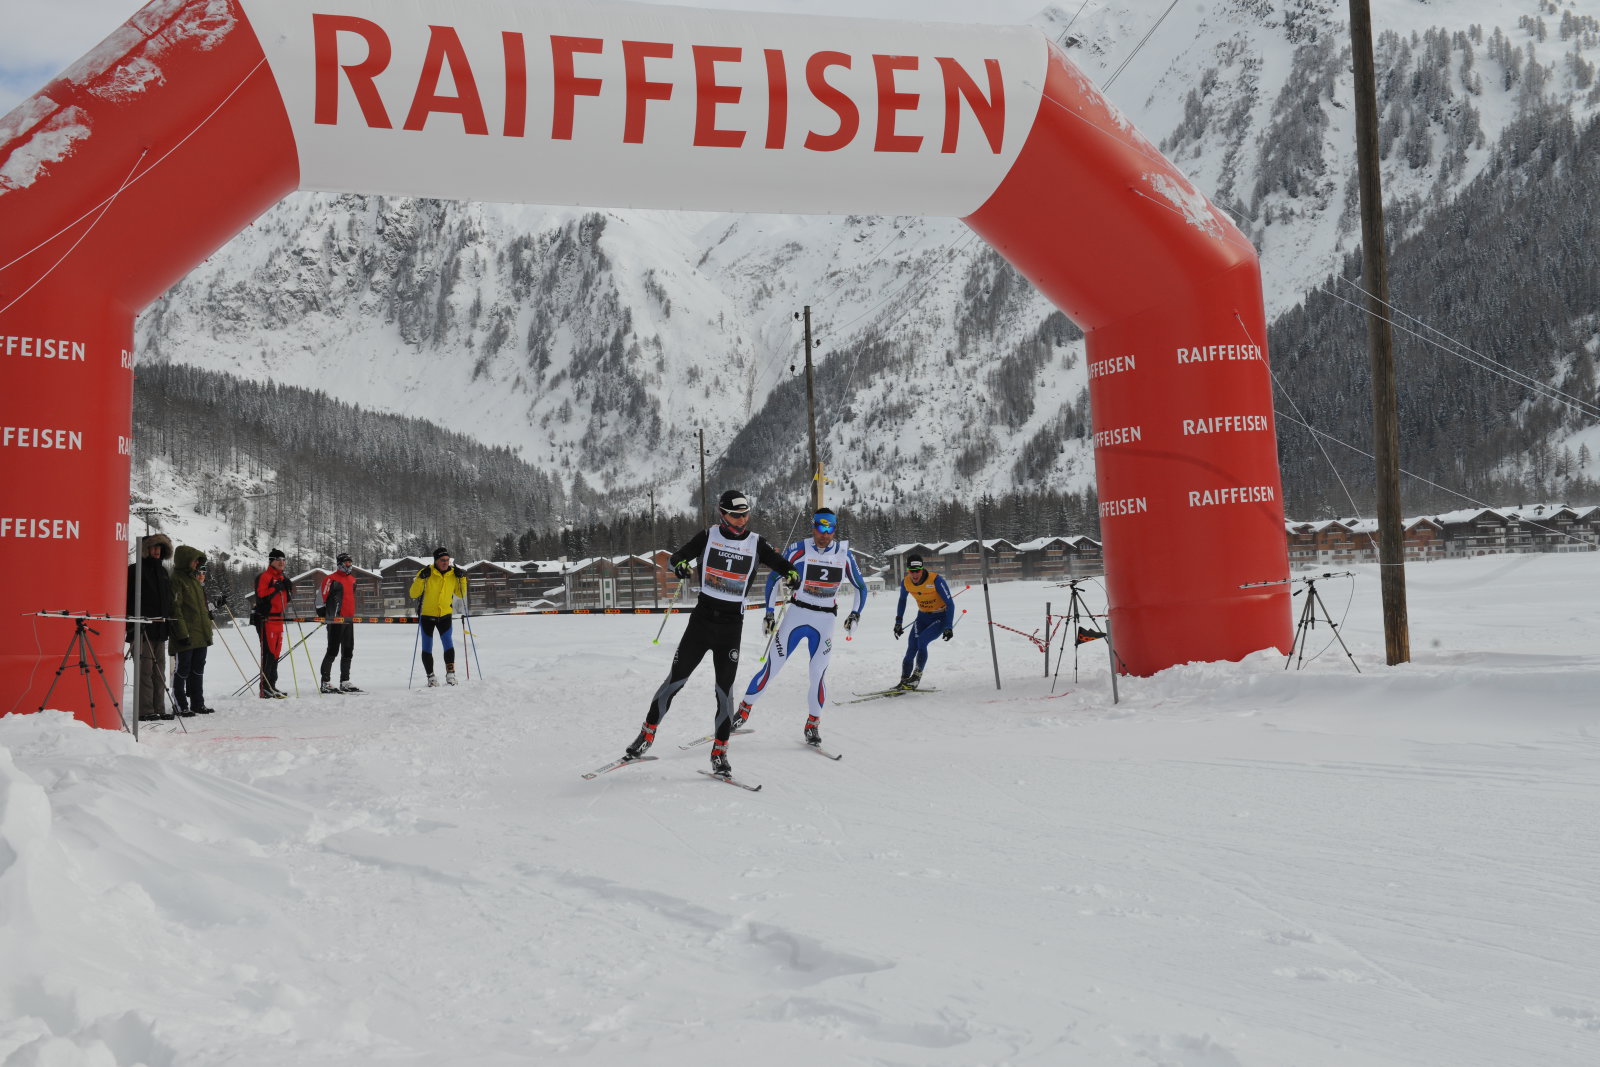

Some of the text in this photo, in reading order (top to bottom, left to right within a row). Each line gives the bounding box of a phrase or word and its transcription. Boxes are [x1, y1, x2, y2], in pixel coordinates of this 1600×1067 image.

[312, 13, 1005, 155] RAIFFEISEN
[1176, 344, 1262, 365] RAIFFEISEN
[1183, 415, 1268, 436] RAIFFEISEN
[0, 427, 82, 451] FEISEN
[1188, 485, 1275, 507] RAIFFEISEN
[0, 517, 80, 540] FEISEN
[718, 551, 744, 561] LECCARDI
[725, 558, 733, 572] 1
[819, 568, 829, 581] 2
